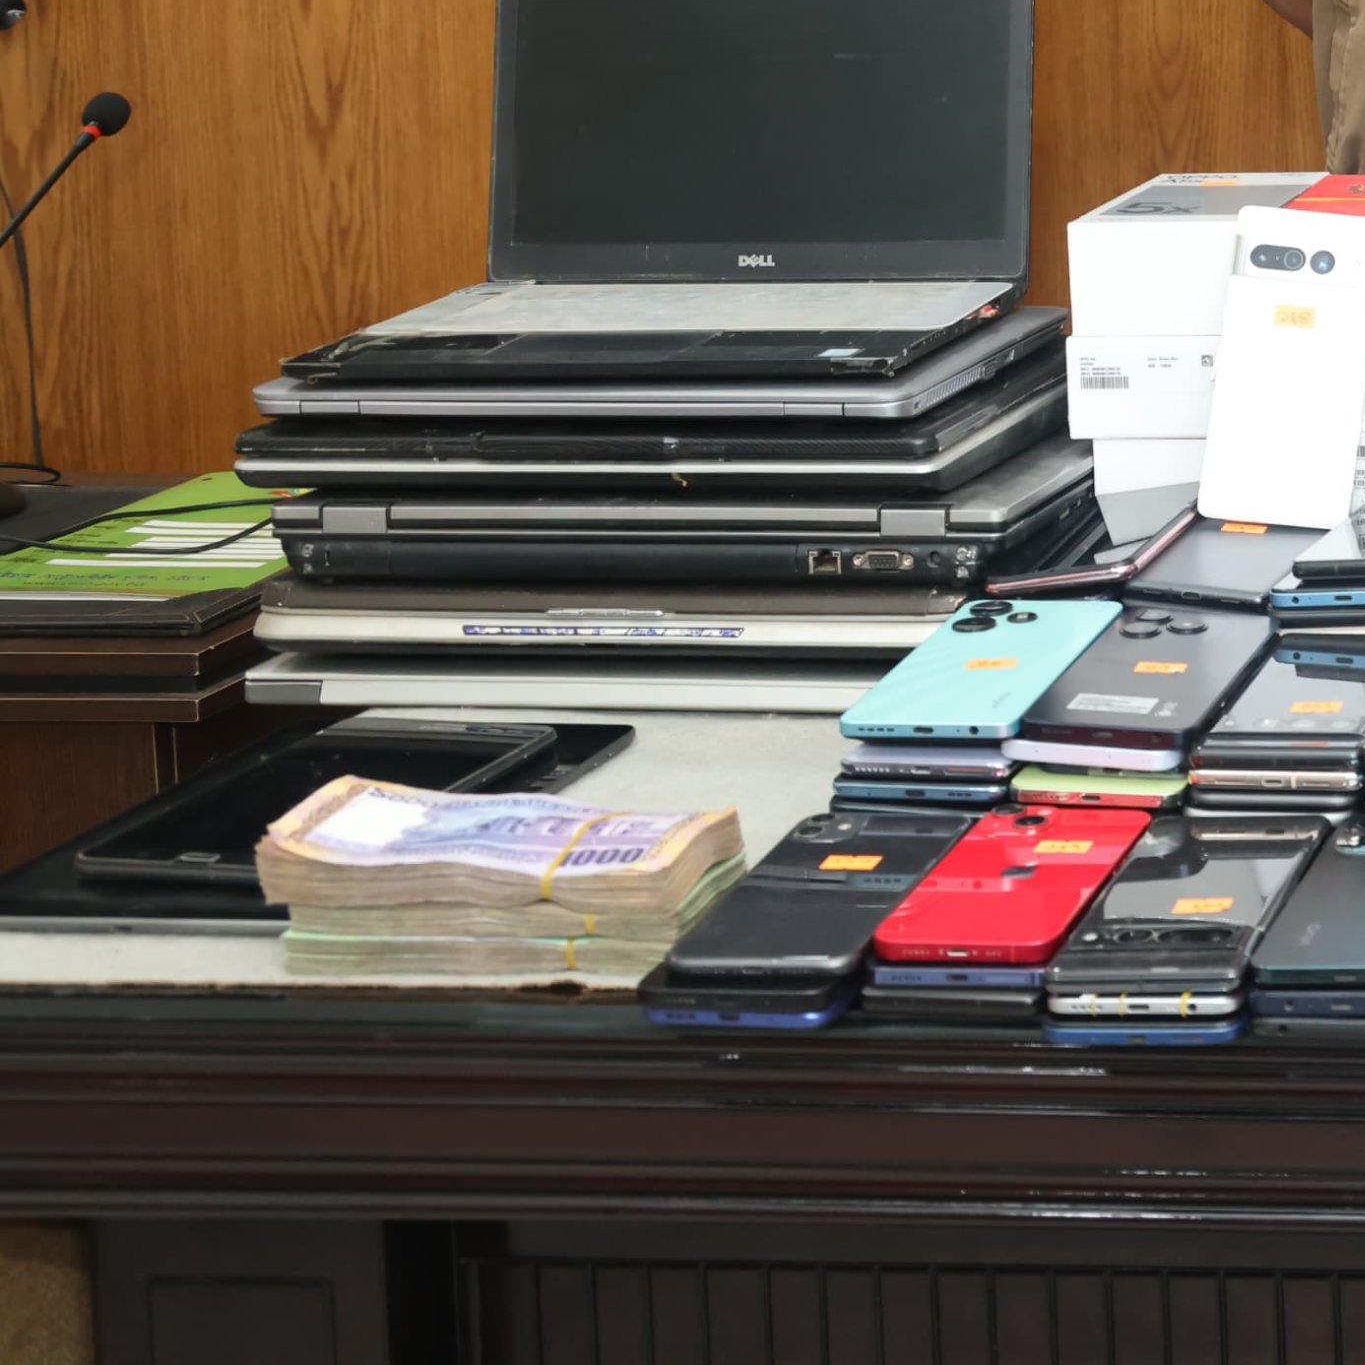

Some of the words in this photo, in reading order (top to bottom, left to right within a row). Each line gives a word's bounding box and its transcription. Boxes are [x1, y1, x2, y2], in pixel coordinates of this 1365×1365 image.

[1116, 202, 1203, 215] 5x
[738, 254, 775, 267] DELL
[559, 848, 644, 867] 1000
